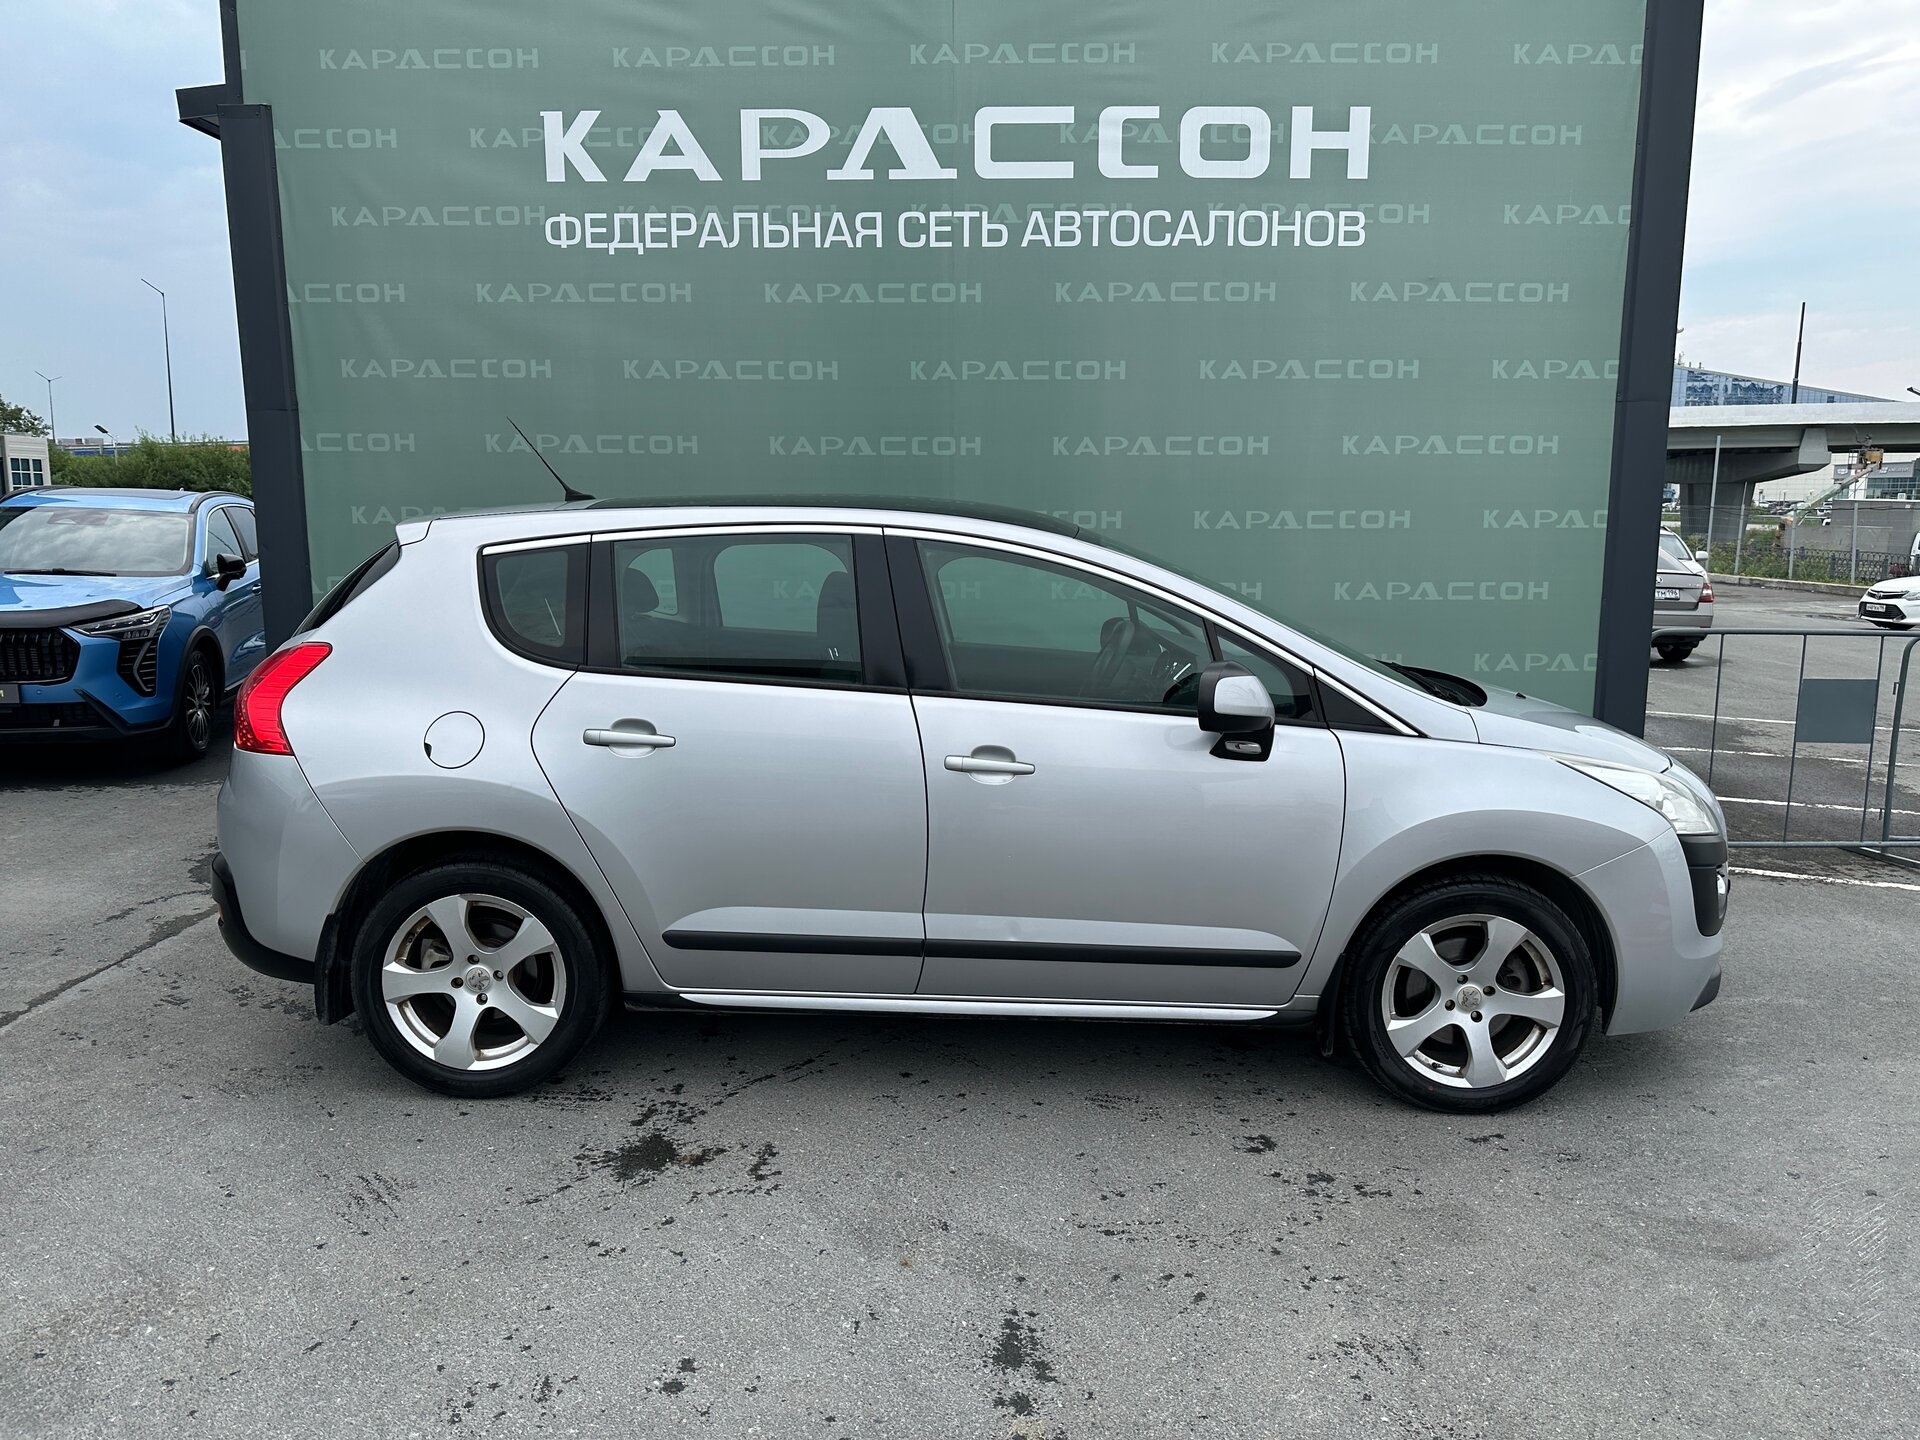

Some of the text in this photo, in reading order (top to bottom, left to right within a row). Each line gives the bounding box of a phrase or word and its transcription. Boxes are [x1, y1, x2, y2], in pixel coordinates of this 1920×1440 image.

[544, 209, 1366, 255] ФЕДЕРАЛЬНАЯ СЕТЬ АВТОСАЛОНОВ
